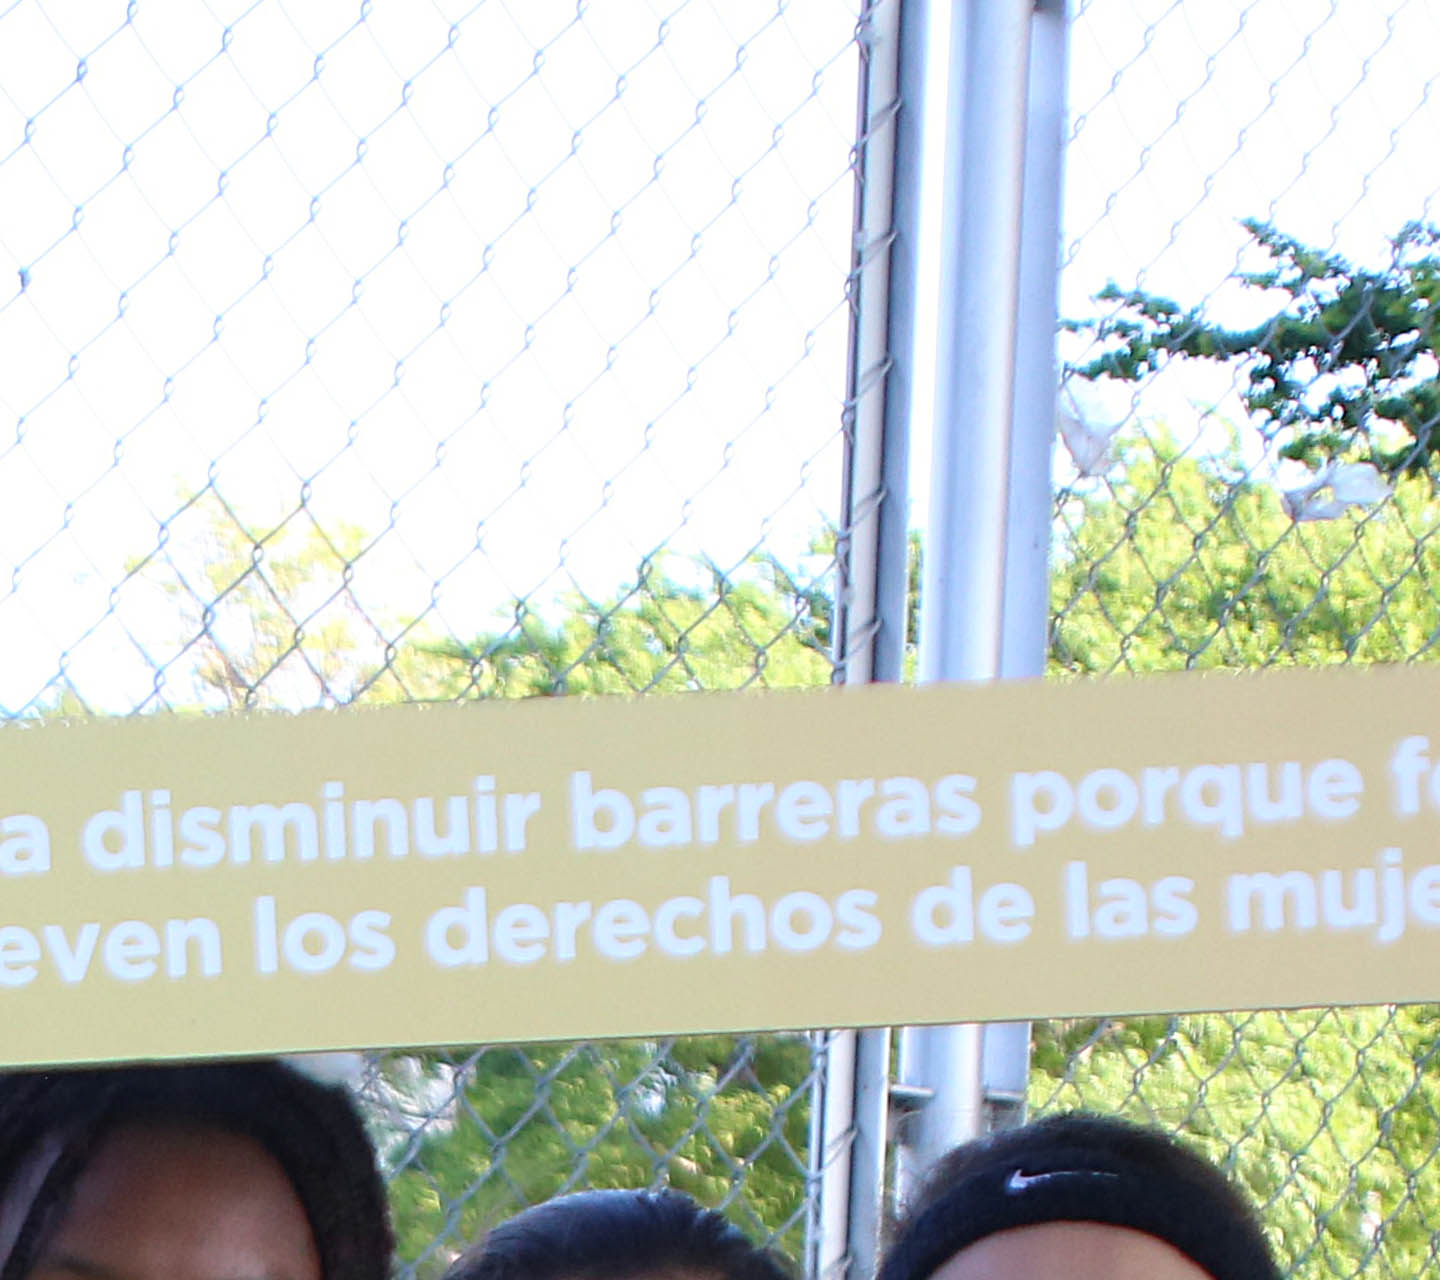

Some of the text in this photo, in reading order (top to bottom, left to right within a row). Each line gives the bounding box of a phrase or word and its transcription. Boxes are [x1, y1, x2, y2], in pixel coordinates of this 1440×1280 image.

[81, 775, 541, 872] disminuir
[570, 771, 982, 851] barreras
[1009, 755, 1364, 848] porque
[254, 895, 396, 975] los
[425, 875, 882, 969] derechos
[910, 865, 1035, 946] de
[1063, 860, 1198, 942] las
